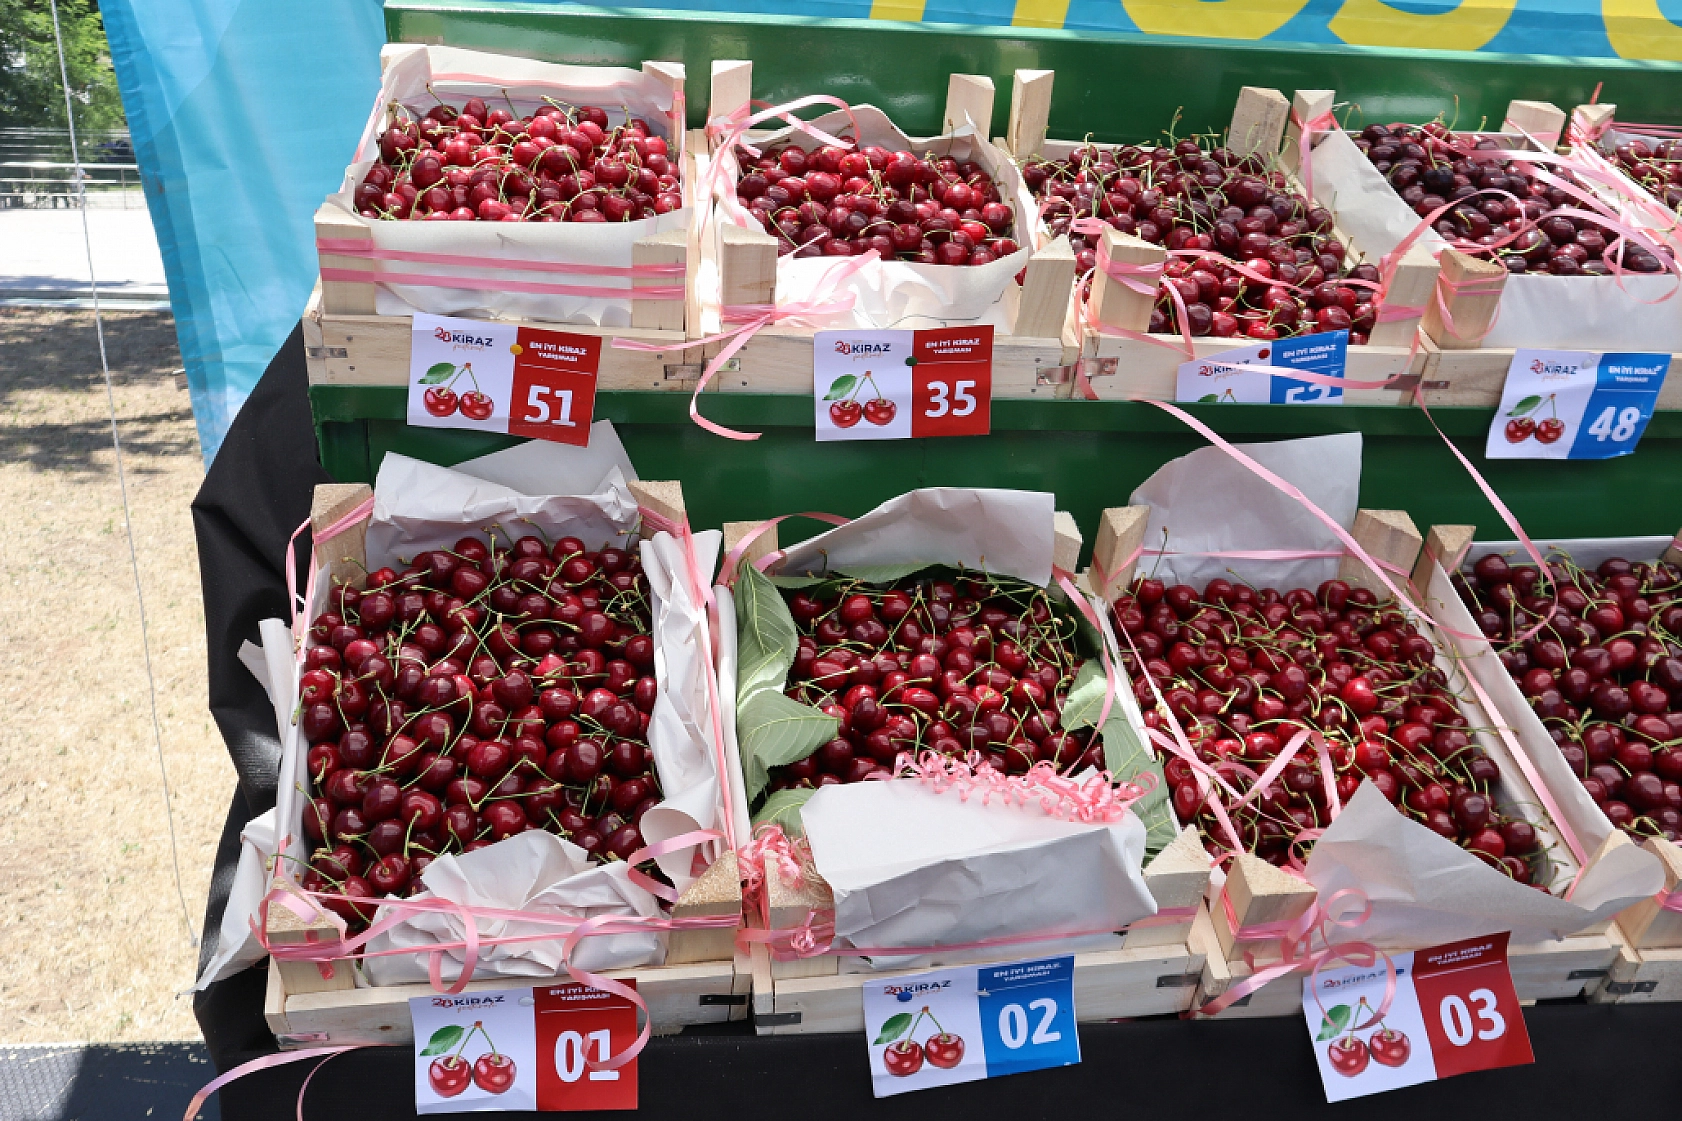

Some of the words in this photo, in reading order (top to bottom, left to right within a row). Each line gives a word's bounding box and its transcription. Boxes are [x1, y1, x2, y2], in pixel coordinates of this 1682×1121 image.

[529, 342, 542, 350] EN
[925, 341, 938, 349] EN
[1608, 365, 1620, 375] EN
[524, 384, 576, 427] 51
[924, 380, 977, 418] 35
[1588, 406, 1641, 442] 48
[999, 998, 1062, 1049] 02
[1440, 988, 1506, 1046] 03
[554, 1029, 620, 1082] 01
